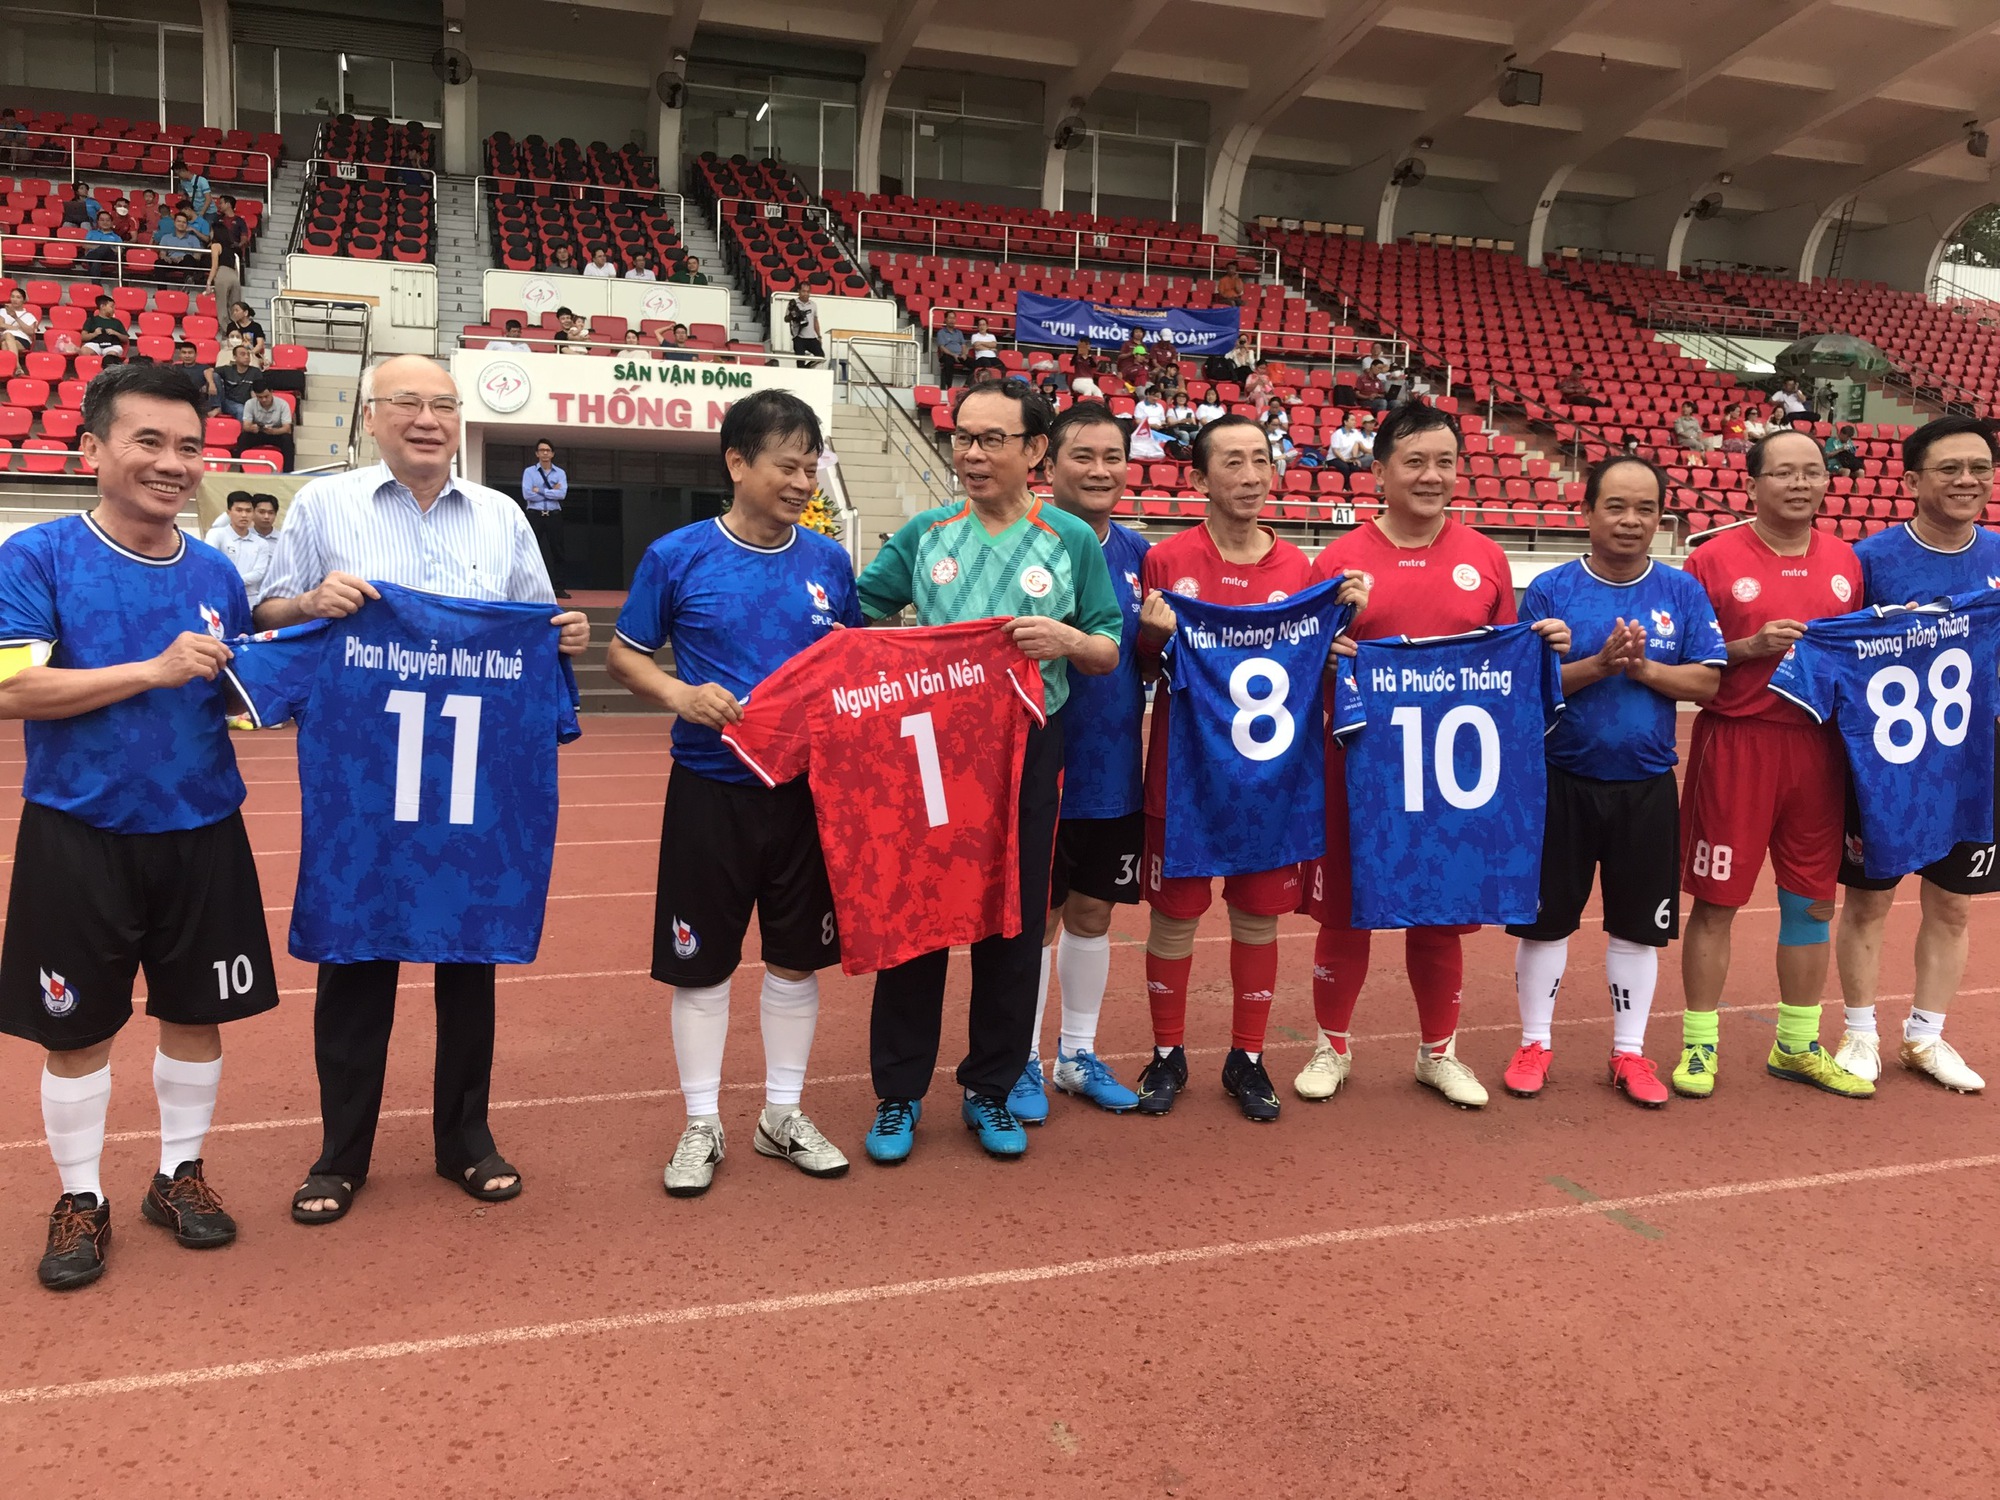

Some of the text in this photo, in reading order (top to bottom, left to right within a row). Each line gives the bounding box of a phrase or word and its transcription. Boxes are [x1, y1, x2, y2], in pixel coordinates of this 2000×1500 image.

[338, 166, 356, 177] VIP
[766, 206, 780, 216] VIP
[1095, 236, 1106, 246] A1
[456, 302, 463, 312] A
[1088, 323, 1130, 341] KHỎE
[613, 361, 753, 388] SÂN VẬN ĐỘNG
[338, 391, 347, 403] E
[549, 385, 692, 429] THỐNG
[335, 416, 344, 427] D
[330, 443, 338, 455] C
[923, 470, 931, 481] C
[1335, 509, 1350, 523] A1
[1397, 558, 1426, 567] mitre
[1781, 568, 1808, 577] mitre
[1221, 576, 1249, 588] mitre
[1185, 621, 1217, 649] Trần
[1221, 624, 1275, 650] Hoàng
[1649, 638, 1676, 651] SPL FC
[1855, 635, 1903, 660] Dương
[1906, 618, 1938, 649] Hồng
[345, 635, 523, 681] Phan Nguyễn Như Khuê
[832, 658, 985, 718] Nguyễn Văn Nên
[1372, 659, 1512, 696] Hà Phước Thắng
[1229, 657, 1295, 761] 8
[1866, 647, 1972, 764] 88
[384, 689, 482, 825] 11
[900, 711, 949, 828] 1
[1390, 704, 1501, 812] 10
[1693, 839, 1733, 881] 88
[1967, 844, 1997, 878] 27
[821, 911, 835, 946] 8
[1654, 898, 1671, 930] 6
[212, 954, 253, 1000] 10
